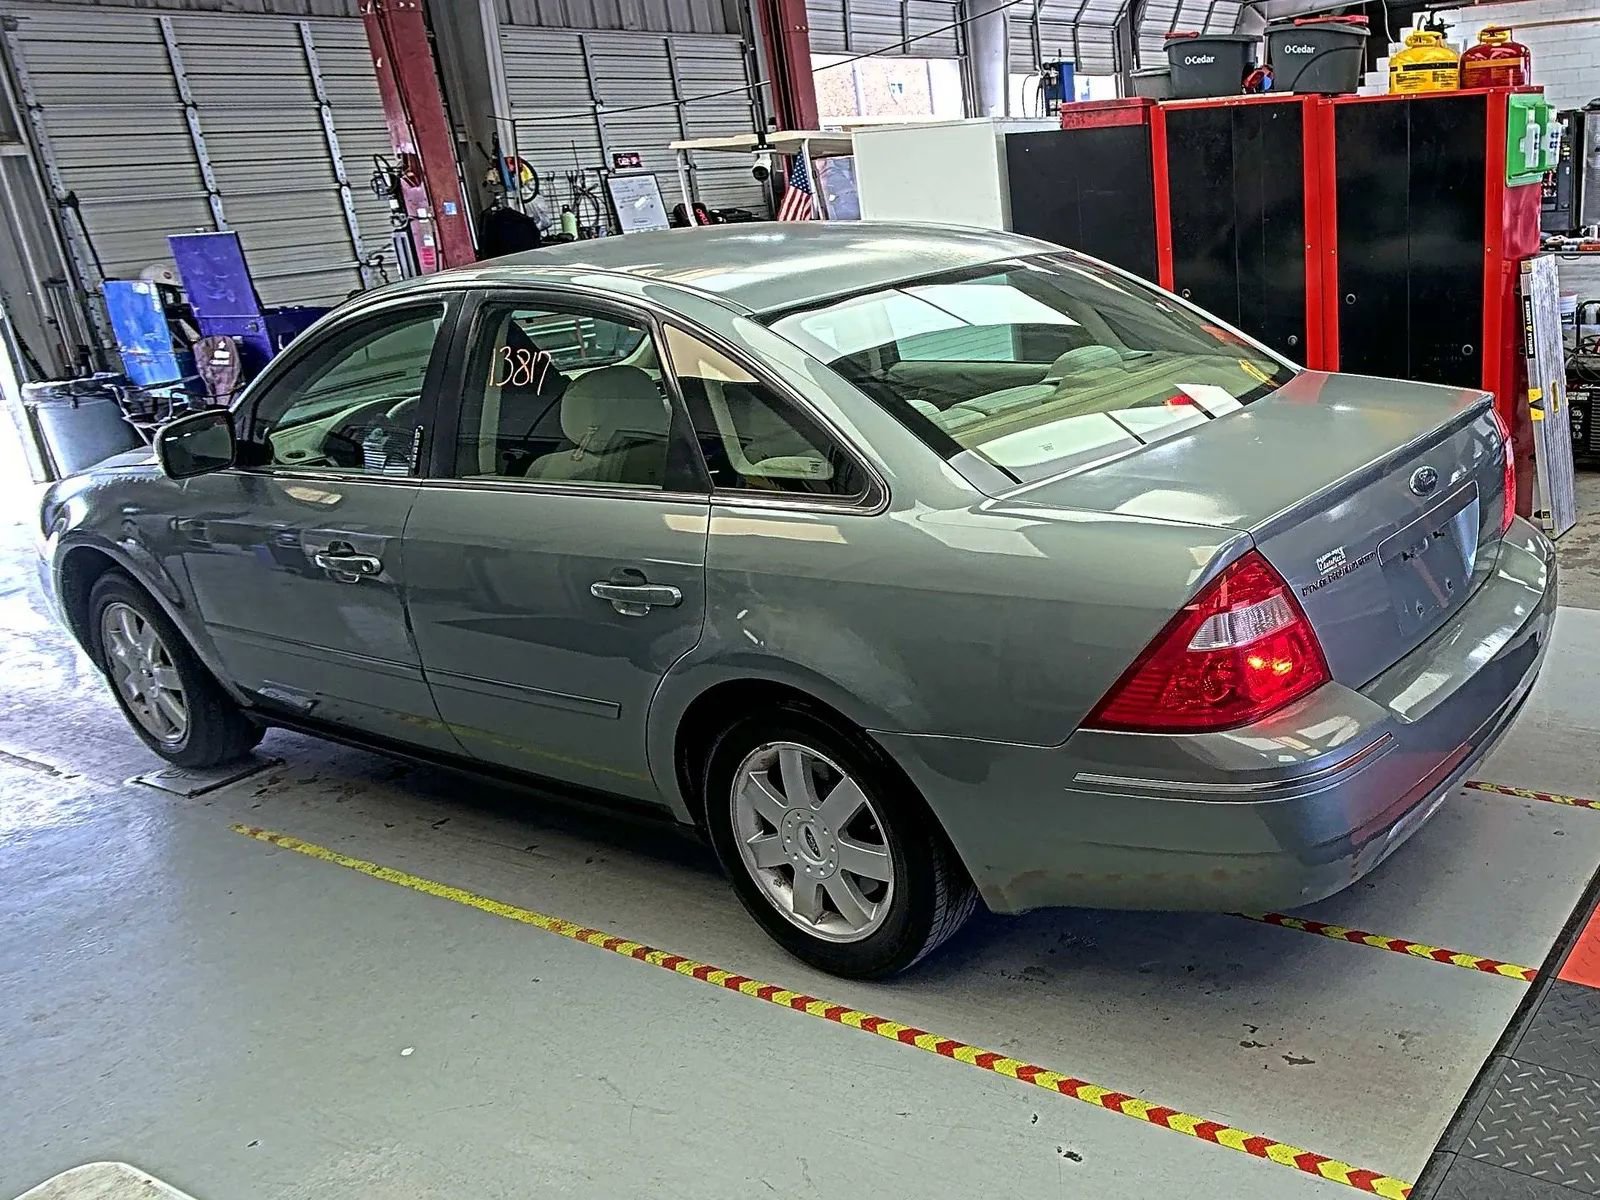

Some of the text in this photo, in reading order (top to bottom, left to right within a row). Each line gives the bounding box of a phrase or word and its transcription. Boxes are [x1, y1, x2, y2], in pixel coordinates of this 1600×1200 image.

[1284, 44, 1316, 54] O-Cedar
[1184, 54, 1215, 65] O-Cedar
[489, 346, 552, 396] 13817
